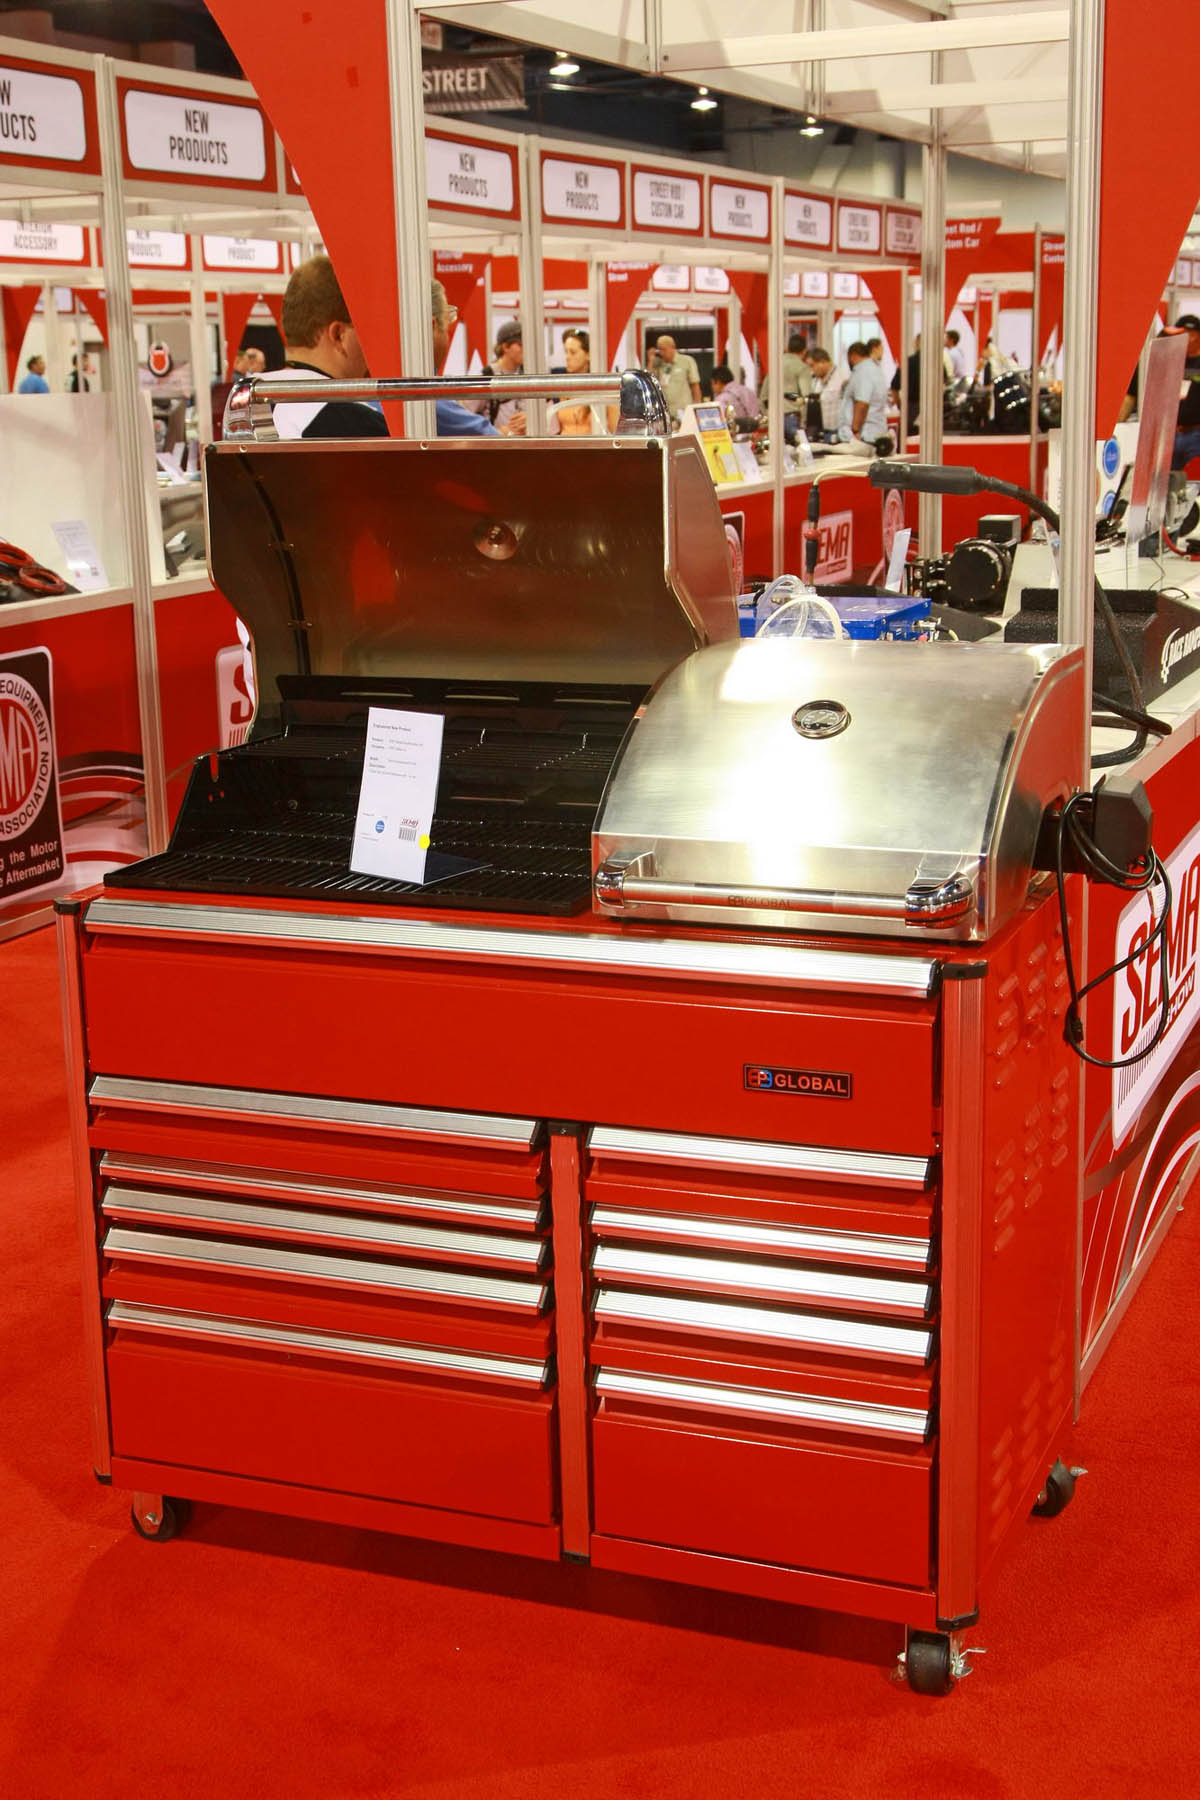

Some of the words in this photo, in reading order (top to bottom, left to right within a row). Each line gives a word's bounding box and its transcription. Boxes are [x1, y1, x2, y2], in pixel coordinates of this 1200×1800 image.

[422, 67, 488, 94] STREET
[184, 109, 209, 133] NEW
[169, 135, 228, 165] PRODUCTS
[458, 153, 476, 172] NEW
[449, 173, 488, 198] PRODUCTS
[575, 170, 589, 189] NEW
[565, 190, 599, 211] PRODUCTS
[817, 522, 851, 564] EMA
[0, 679, 49, 744] EQUIPMENT
[9, 850, 25, 865] the
[30, 840, 58, 857] Motor
[6, 856, 61, 885] Aftermarket
[1121, 852, 1200, 1056] SEMA
[774, 1073, 848, 1094] GLOBAL
